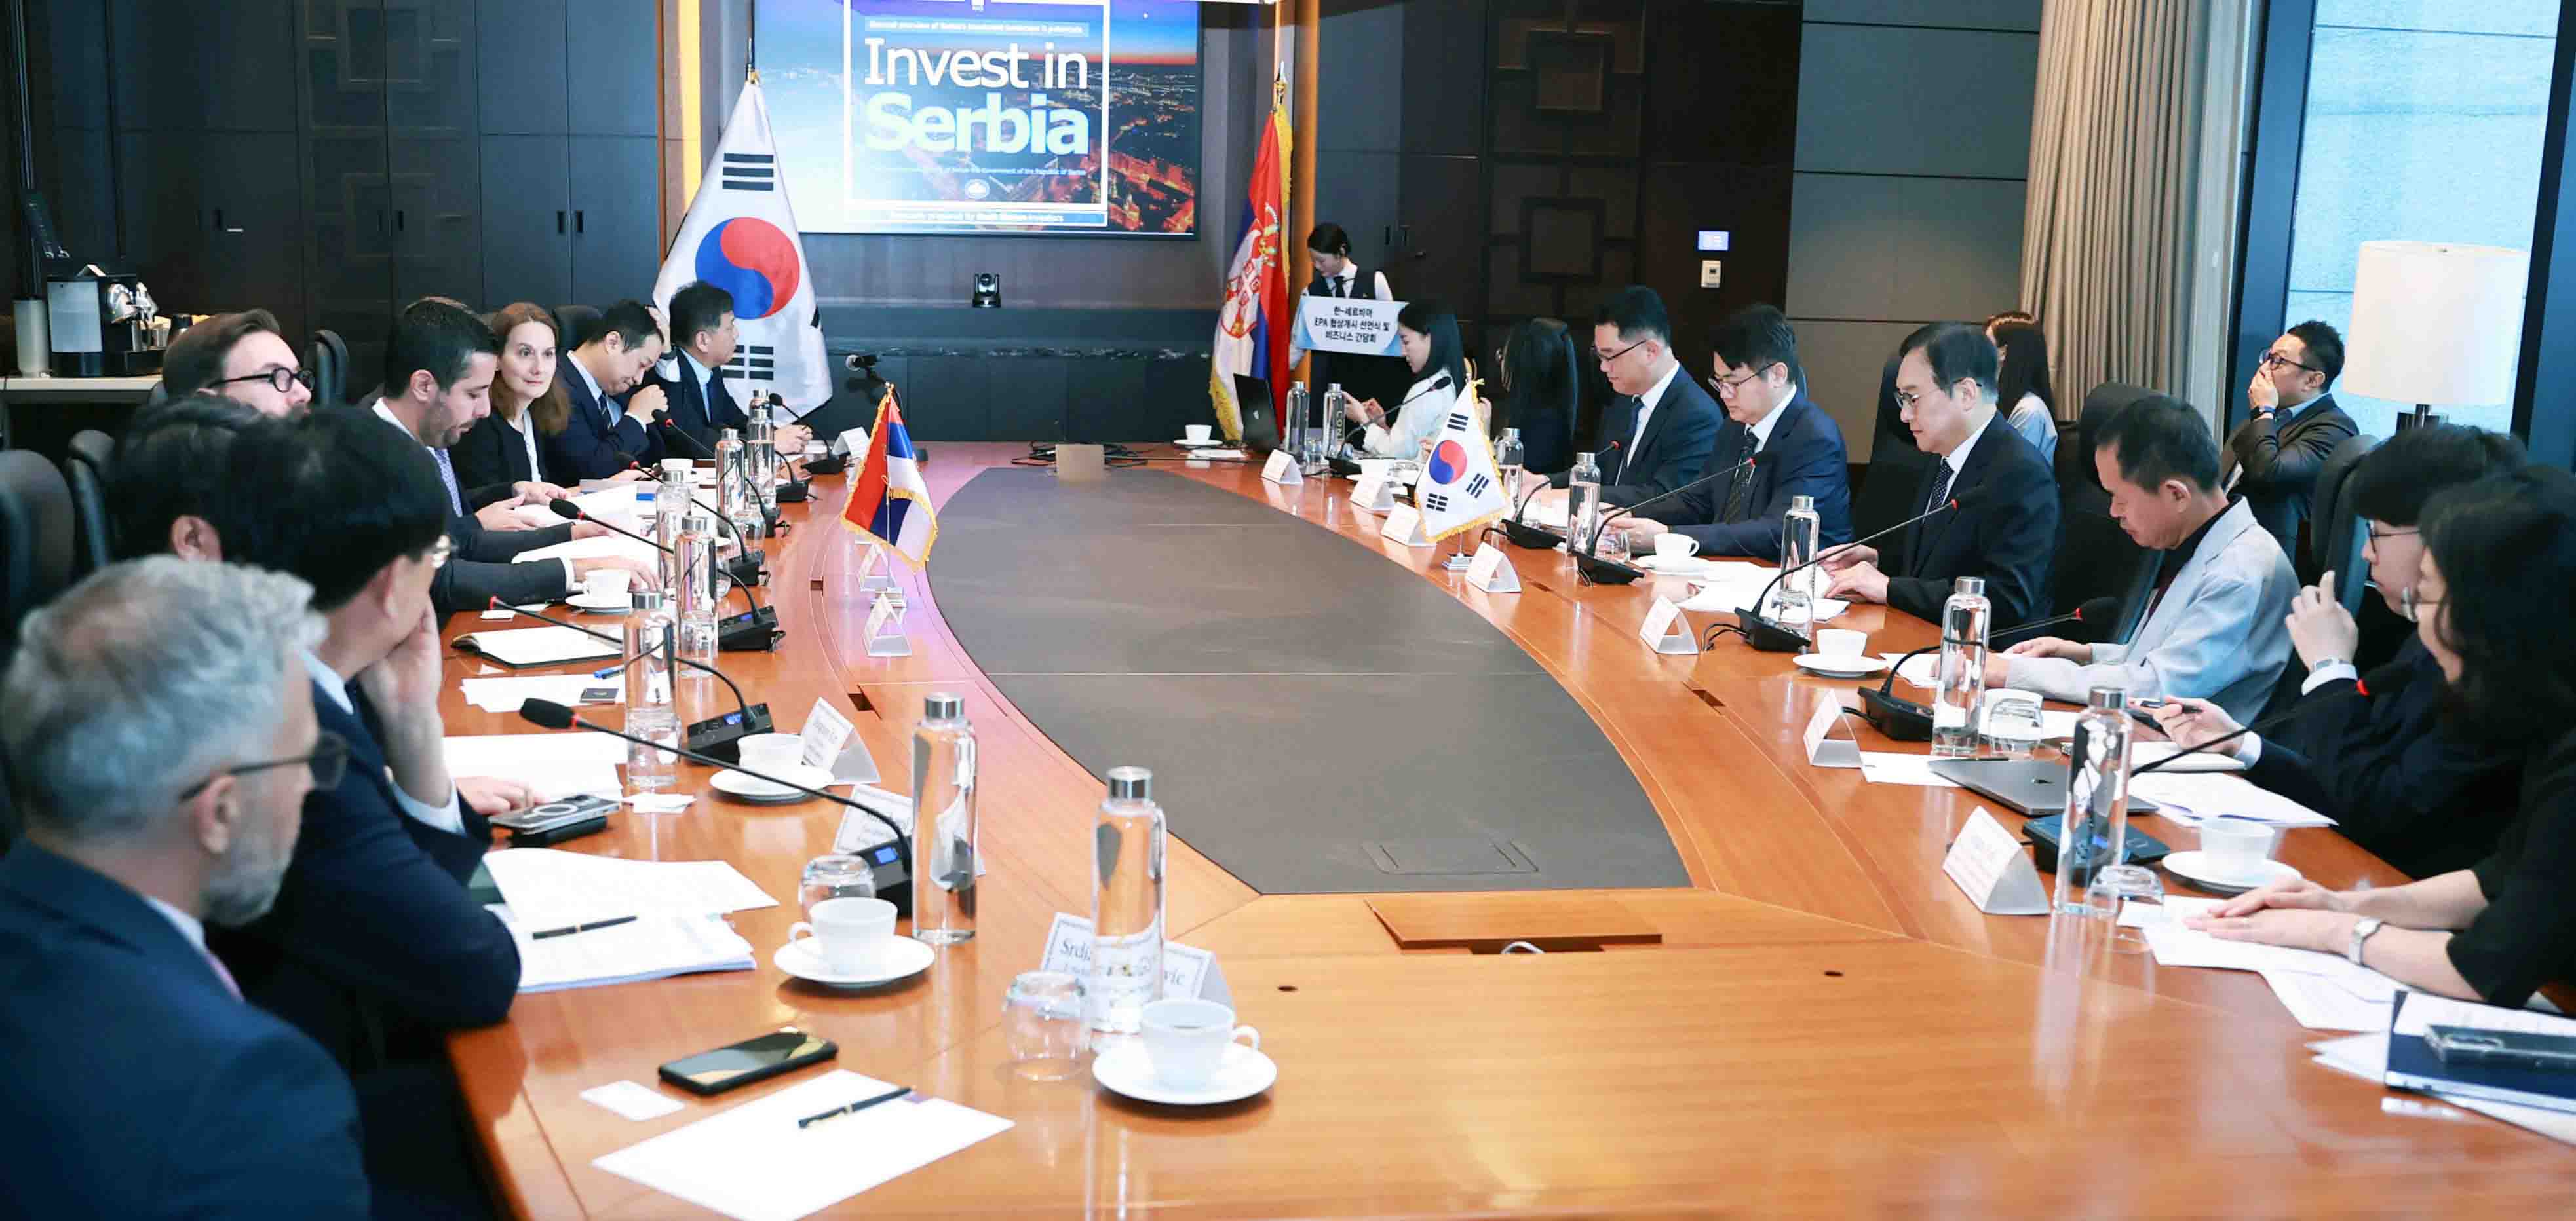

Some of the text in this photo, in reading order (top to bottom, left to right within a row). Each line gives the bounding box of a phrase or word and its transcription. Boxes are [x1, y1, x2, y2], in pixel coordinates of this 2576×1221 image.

[865, 37, 1087, 89] Invest in
[865, 92, 1088, 155] Serbia
[1315, 317, 1328, 327] EPA
[1326, 331, 1377, 343] 비즈니스 간담회
